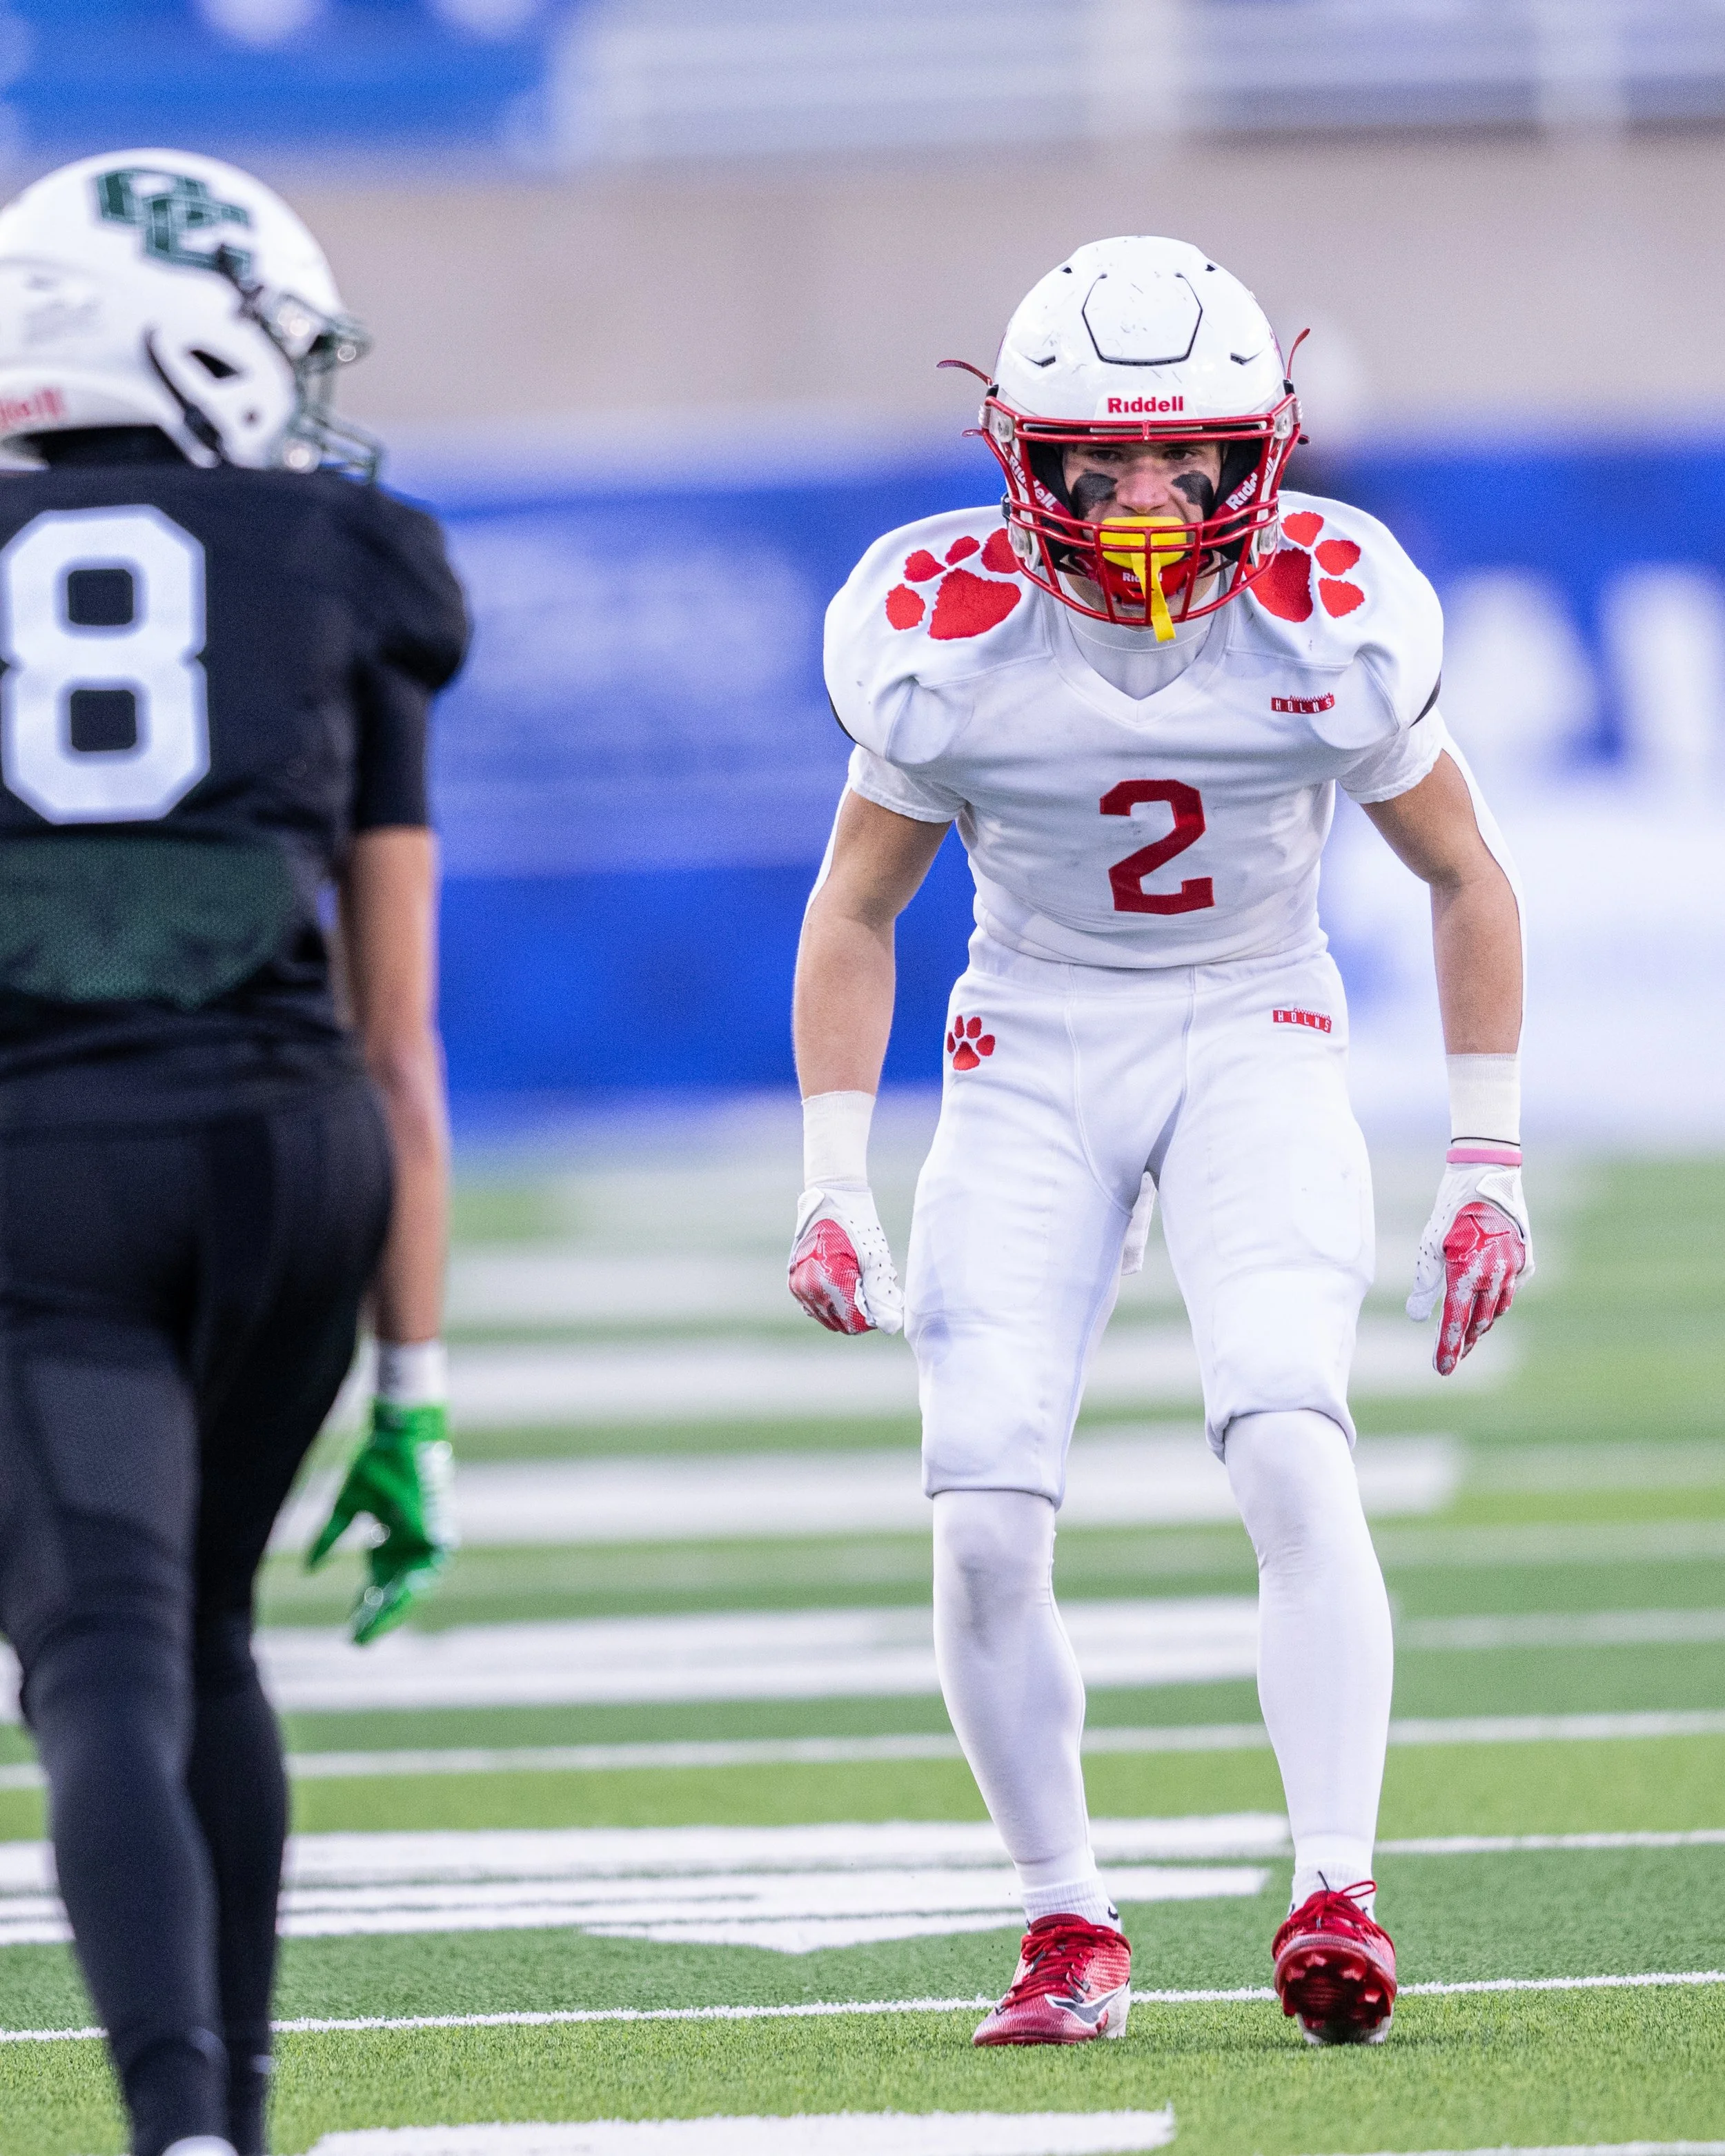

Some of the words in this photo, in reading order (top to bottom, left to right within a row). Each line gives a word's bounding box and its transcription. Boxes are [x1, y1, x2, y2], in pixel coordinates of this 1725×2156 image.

[1107, 396, 1183, 413] Riddell
[1, 504, 210, 824] 8
[1100, 779, 1215, 915] 2
